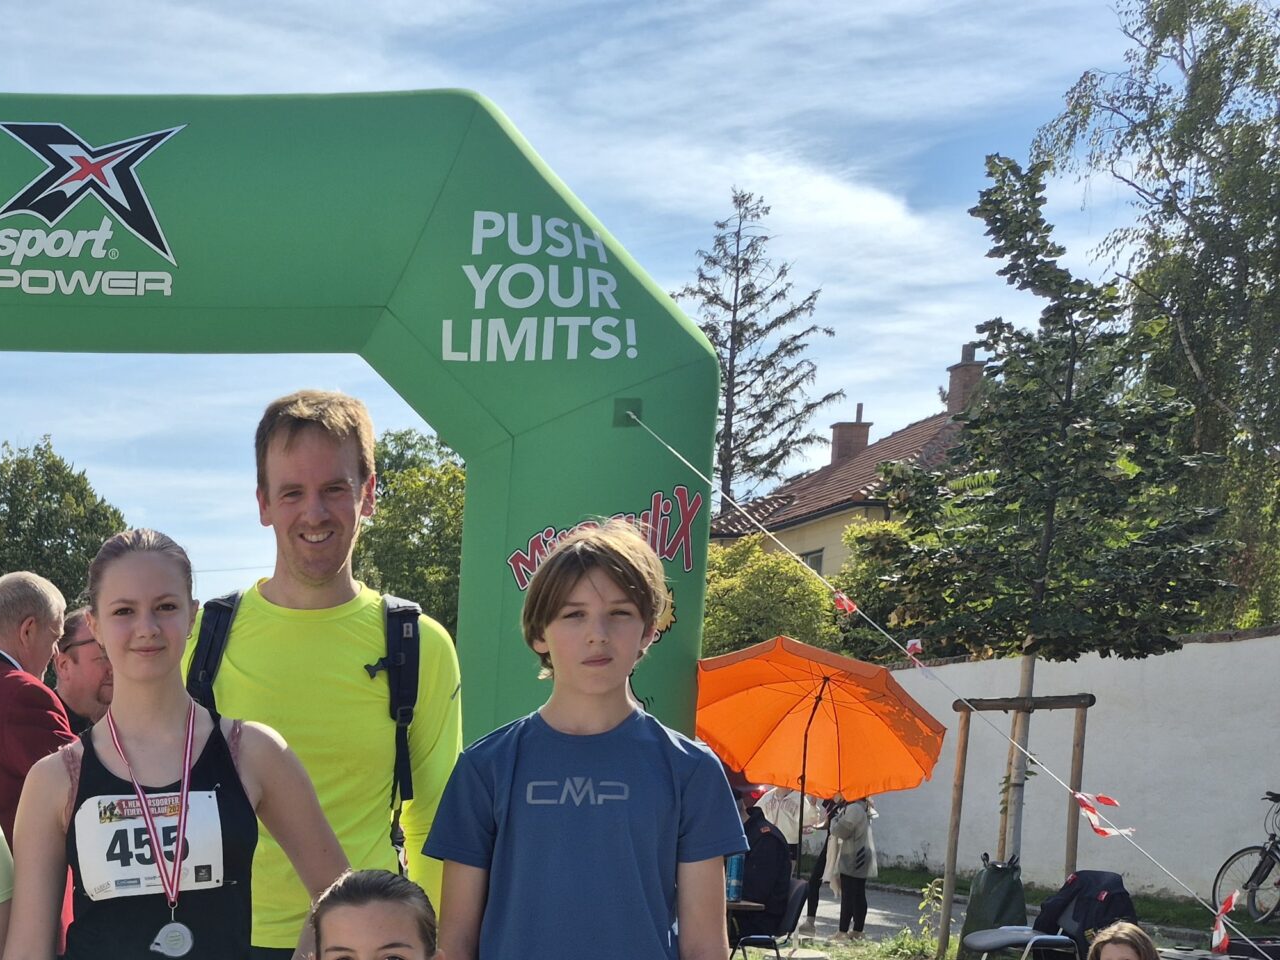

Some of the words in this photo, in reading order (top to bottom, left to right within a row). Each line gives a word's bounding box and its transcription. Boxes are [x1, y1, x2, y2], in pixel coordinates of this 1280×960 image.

[471, 210, 609, 263] PUSH
[461, 262, 621, 310] YOUR
[441, 316, 639, 362] LIMITS!
[128, 796, 180, 808] HENRSDORFER
[526, 777, 630, 807] CMP
[106, 825, 190, 868] 455
